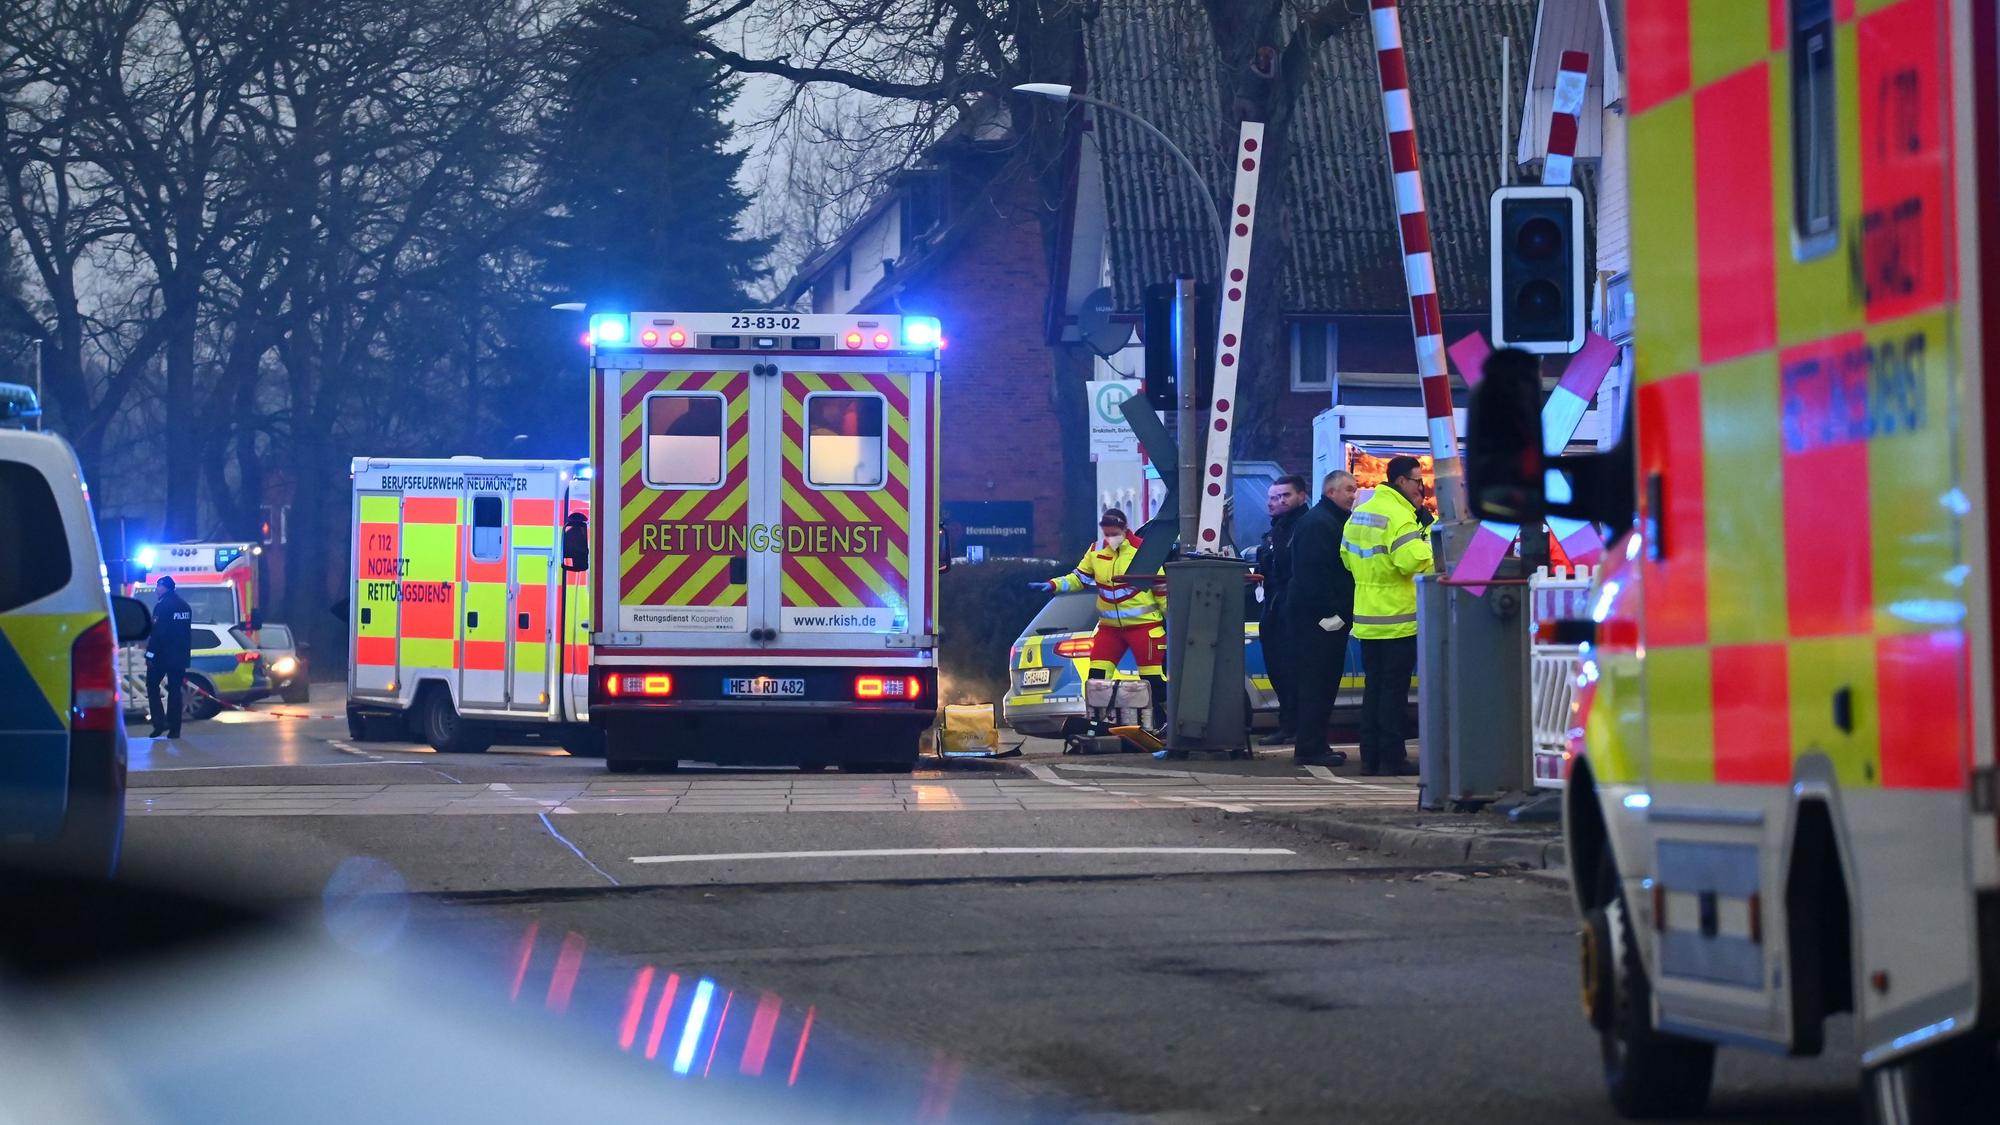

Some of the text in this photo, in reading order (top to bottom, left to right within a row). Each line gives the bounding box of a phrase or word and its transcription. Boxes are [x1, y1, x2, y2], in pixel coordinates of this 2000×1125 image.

[731, 316, 801, 330] 23-83-02
[382, 475, 528, 491] BERUFSFEUERWEHR NEUMÜNSTER
[642, 523, 883, 553] RETTUNGSDIENST
[966, 525, 1027, 537] Henningsen
[378, 534, 392, 551] 112
[368, 558, 410, 577] NOTARZT
[368, 582, 452, 604] RETTUNGSDIENST
[633, 614, 734, 623] Rettungsdienst Kooperation
[794, 614, 876, 627] www.rkish.de
[730, 680, 804, 694] HEI RD 482
